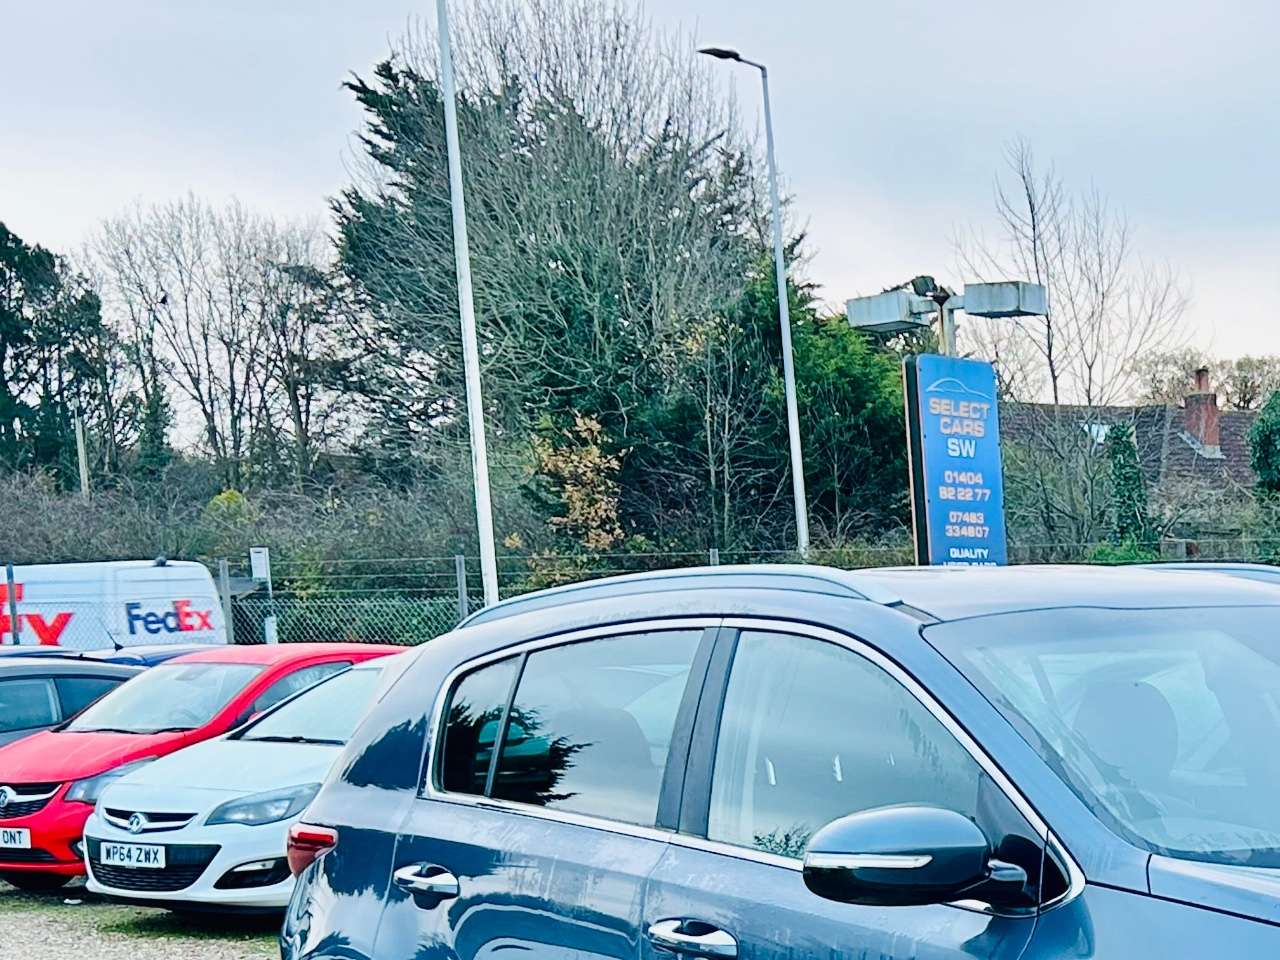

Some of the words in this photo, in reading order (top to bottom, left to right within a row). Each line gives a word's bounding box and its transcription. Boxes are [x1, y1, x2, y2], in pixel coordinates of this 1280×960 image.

[928, 397, 991, 419] SELECT
[940, 416, 985, 438] CARS
[947, 437, 976, 458] SW
[944, 470, 983, 485] 01404
[949, 547, 989, 559] QUALITY
[125, 599, 215, 635] FedEx
[105, 844, 132, 862] WP64
[135, 847, 159, 864] ZWX
